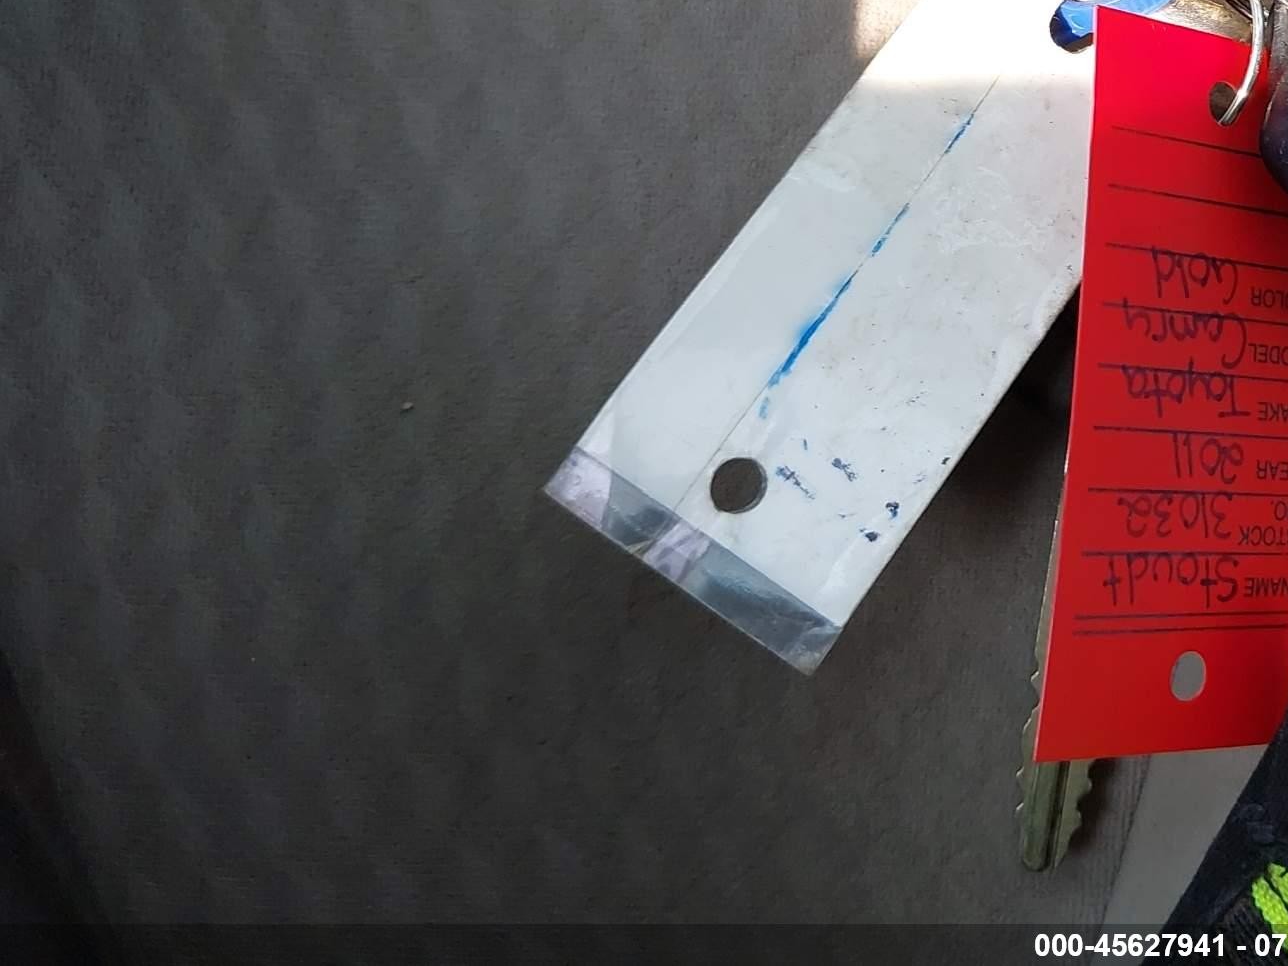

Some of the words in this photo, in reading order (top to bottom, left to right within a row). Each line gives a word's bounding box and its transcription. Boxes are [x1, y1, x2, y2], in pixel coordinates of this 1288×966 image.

[1150, 245, 1239, 306] Gold
[1122, 297, 1248, 369] Camry
[1121, 356, 1252, 419] Toyota
[1172, 432, 1244, 485] 2011
[1117, 490, 1233, 539] 31032
